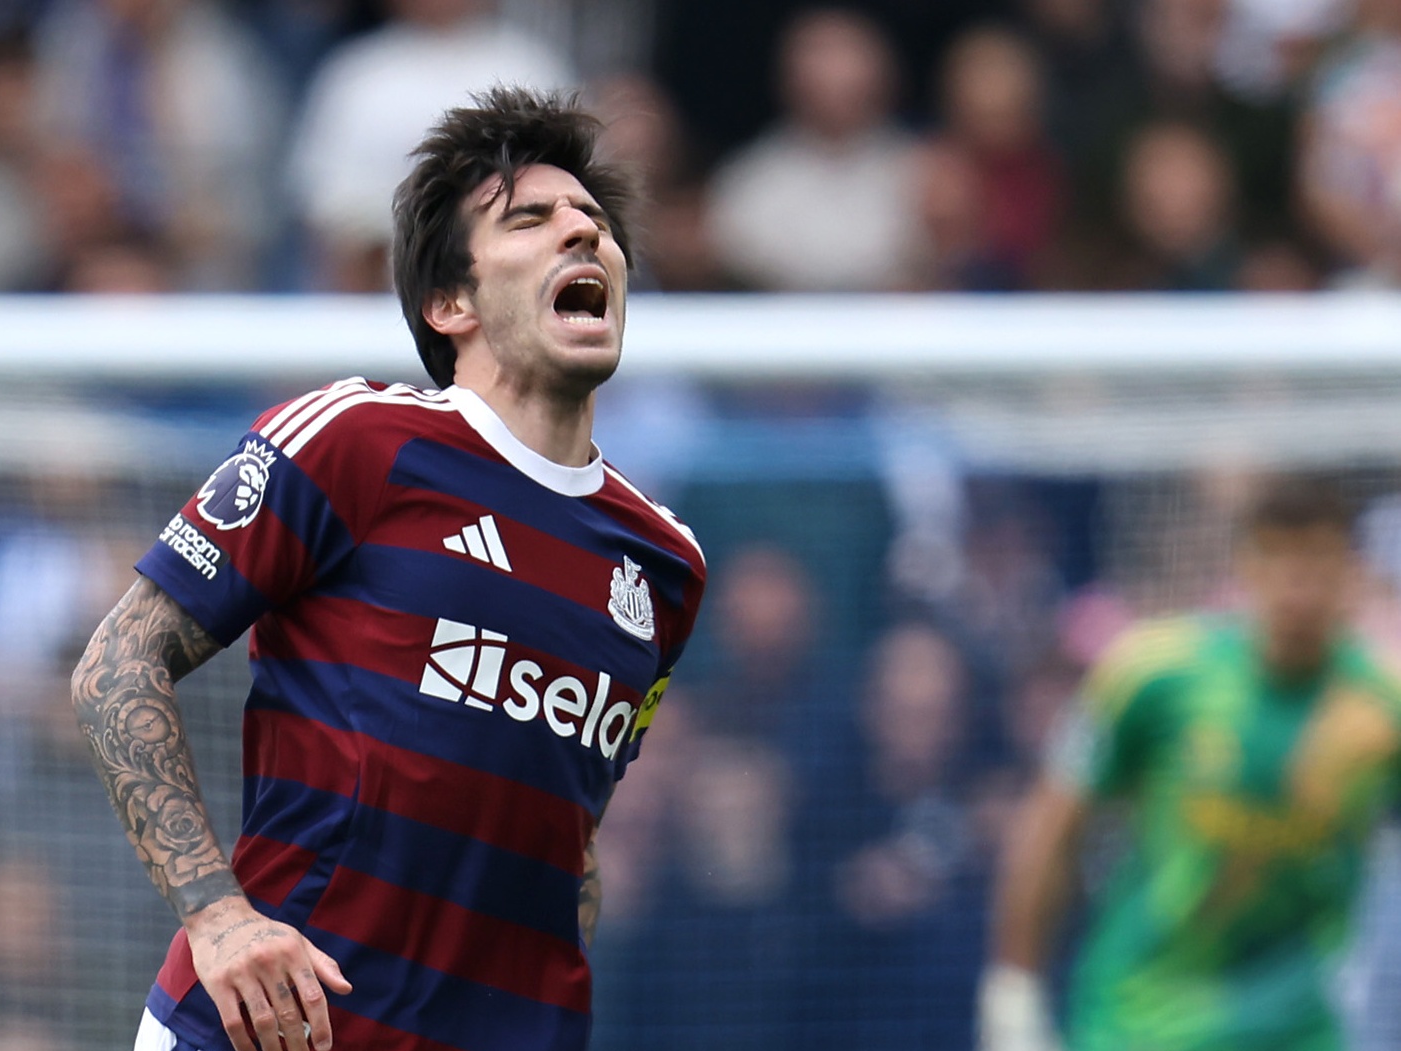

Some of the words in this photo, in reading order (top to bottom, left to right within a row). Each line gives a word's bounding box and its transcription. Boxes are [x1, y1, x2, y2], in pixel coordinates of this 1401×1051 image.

[167, 533, 217, 580] racism
[178, 523, 221, 564] room
[502, 659, 637, 761] sela
